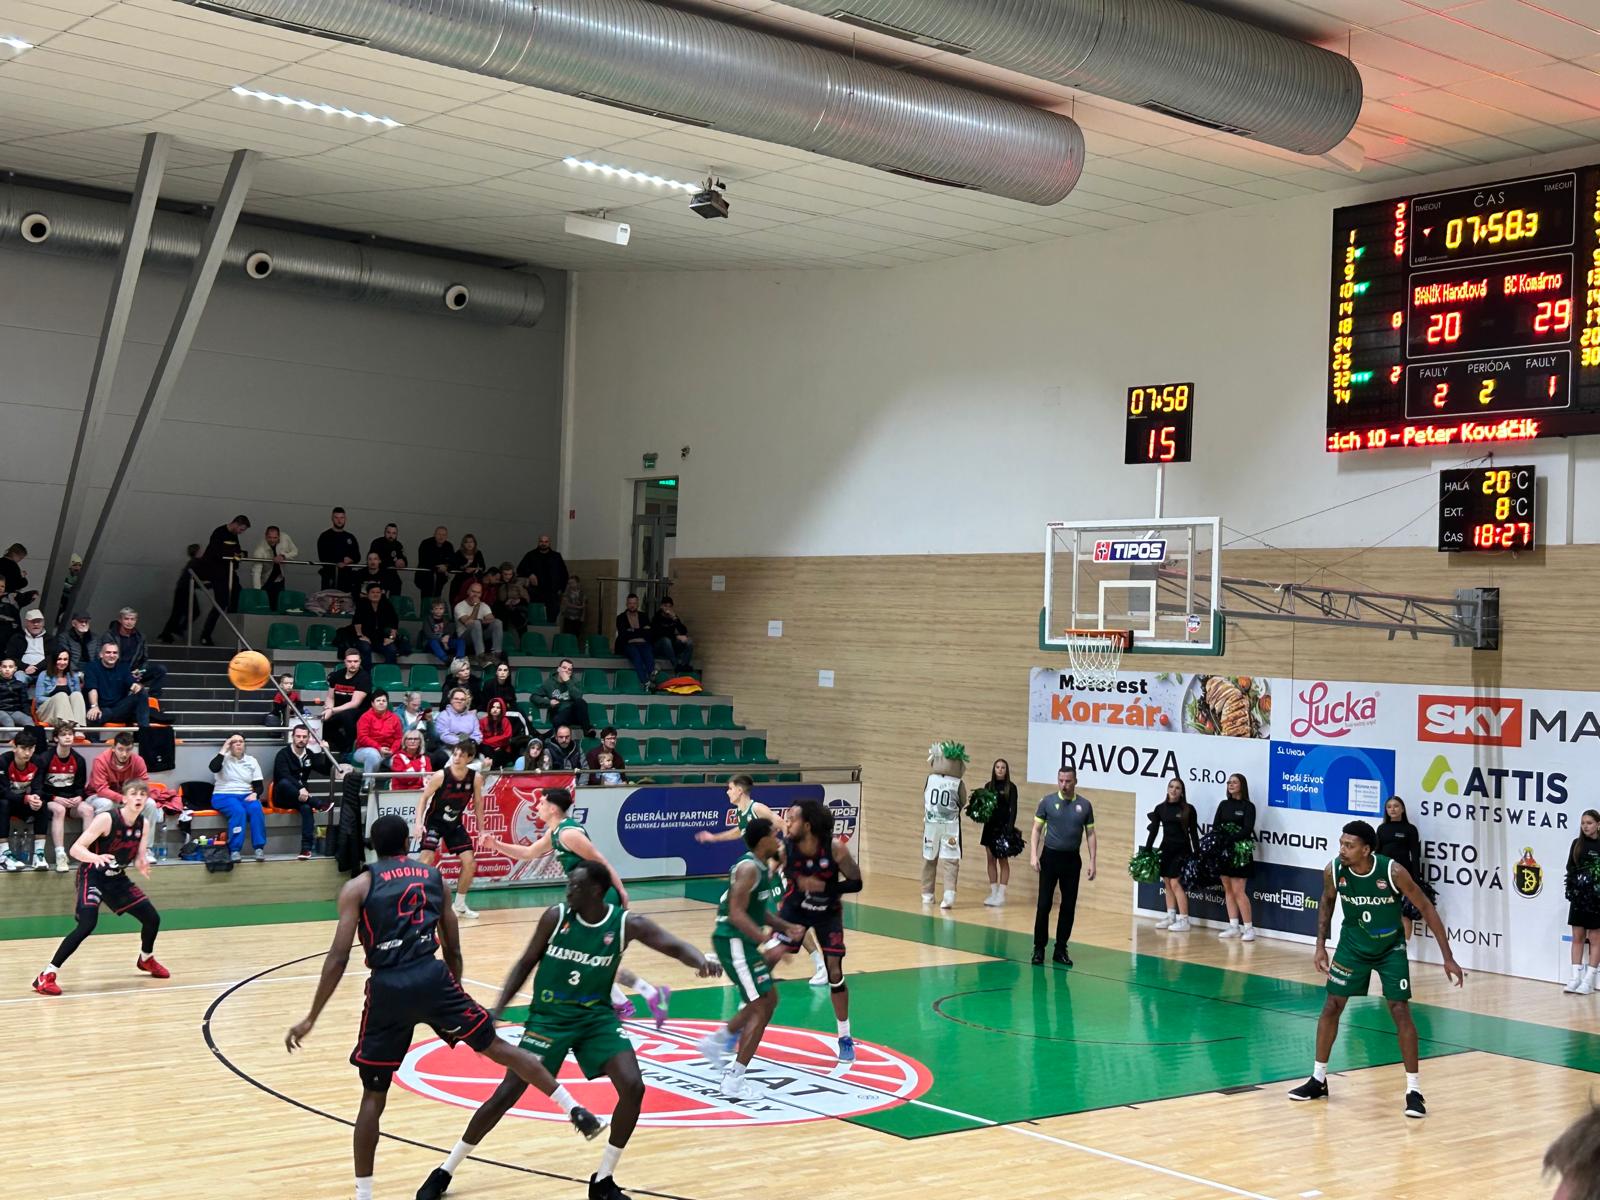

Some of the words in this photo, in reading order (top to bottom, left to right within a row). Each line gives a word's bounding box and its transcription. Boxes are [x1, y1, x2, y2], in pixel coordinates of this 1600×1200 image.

[1544, 181, 1574, 192] TIMEOUT
[1415, 202, 1441, 213] TIMEOUT
[1474, 190, 1505, 208] ČAS
[1395, 202, 1407, 219] 2
[1394, 220, 1406, 238] 2
[1345, 246, 1355, 264] 3
[1394, 238, 1406, 256] 6
[1344, 264, 1355, 281] 9
[1339, 281, 1354, 299] 10
[1442, 278, 1488, 302] Handlová
[1504, 276, 1517, 294] BC
[1519, 271, 1562, 292] Komárno
[1339, 301, 1353, 316] 14
[1534, 298, 1572, 333] 29
[1338, 317, 1353, 335] 18
[1427, 312, 1461, 344] 20
[1333, 336, 1353, 353] 24
[1580, 325, 1600, 346] 20
[1332, 353, 1352, 370] 25
[1467, 361, 1511, 374] PERIÓDA
[1525, 356, 1557, 369] FAULY
[1333, 371, 1351, 387] 32
[1390, 365, 1402, 383] 2
[1419, 367, 1448, 378] FAULY
[1433, 383, 1449, 408] 2
[1479, 378, 1496, 404] 2
[1549, 375, 1559, 399] 1
[1130, 385, 1189, 415] 07:58
[1366, 428, 1387, 448] 10
[1402, 424, 1457, 447] Peter
[1461, 417, 1540, 443] Kováčik
[1149, 426, 1176, 460] 15
[1444, 481, 1470, 492] HALA
[1444, 507, 1464, 517] EXT.
[1443, 531, 1464, 542] ČAS
[1473, 522, 1530, 547] 18:27
[1113, 542, 1162, 559] TIPOS
[1051, 693, 1162, 727] Korzár
[1290, 682, 1378, 738] Lucka
[1424, 703, 1515, 738] SKY
[1529, 708, 1600, 743] MA
[1061, 740, 1180, 779] RAVOZA
[1282, 783, 1319, 794] spoločne
[1302, 774, 1324, 785] život
[1463, 766, 1569, 805] ATTIS
[379, 806, 416, 816] GENER
[624, 810, 678, 822] GENERÁLNY
[679, 810, 719, 820] PARTNER
[1420, 800, 1569, 830] SPORTSWEAR
[380, 866, 430, 882] WIGGINS
[397, 881, 428, 925] 4
[1362, 910, 1372, 923] 0
[568, 970, 581, 986] 3
[1400, 979, 1408, 991] 0
